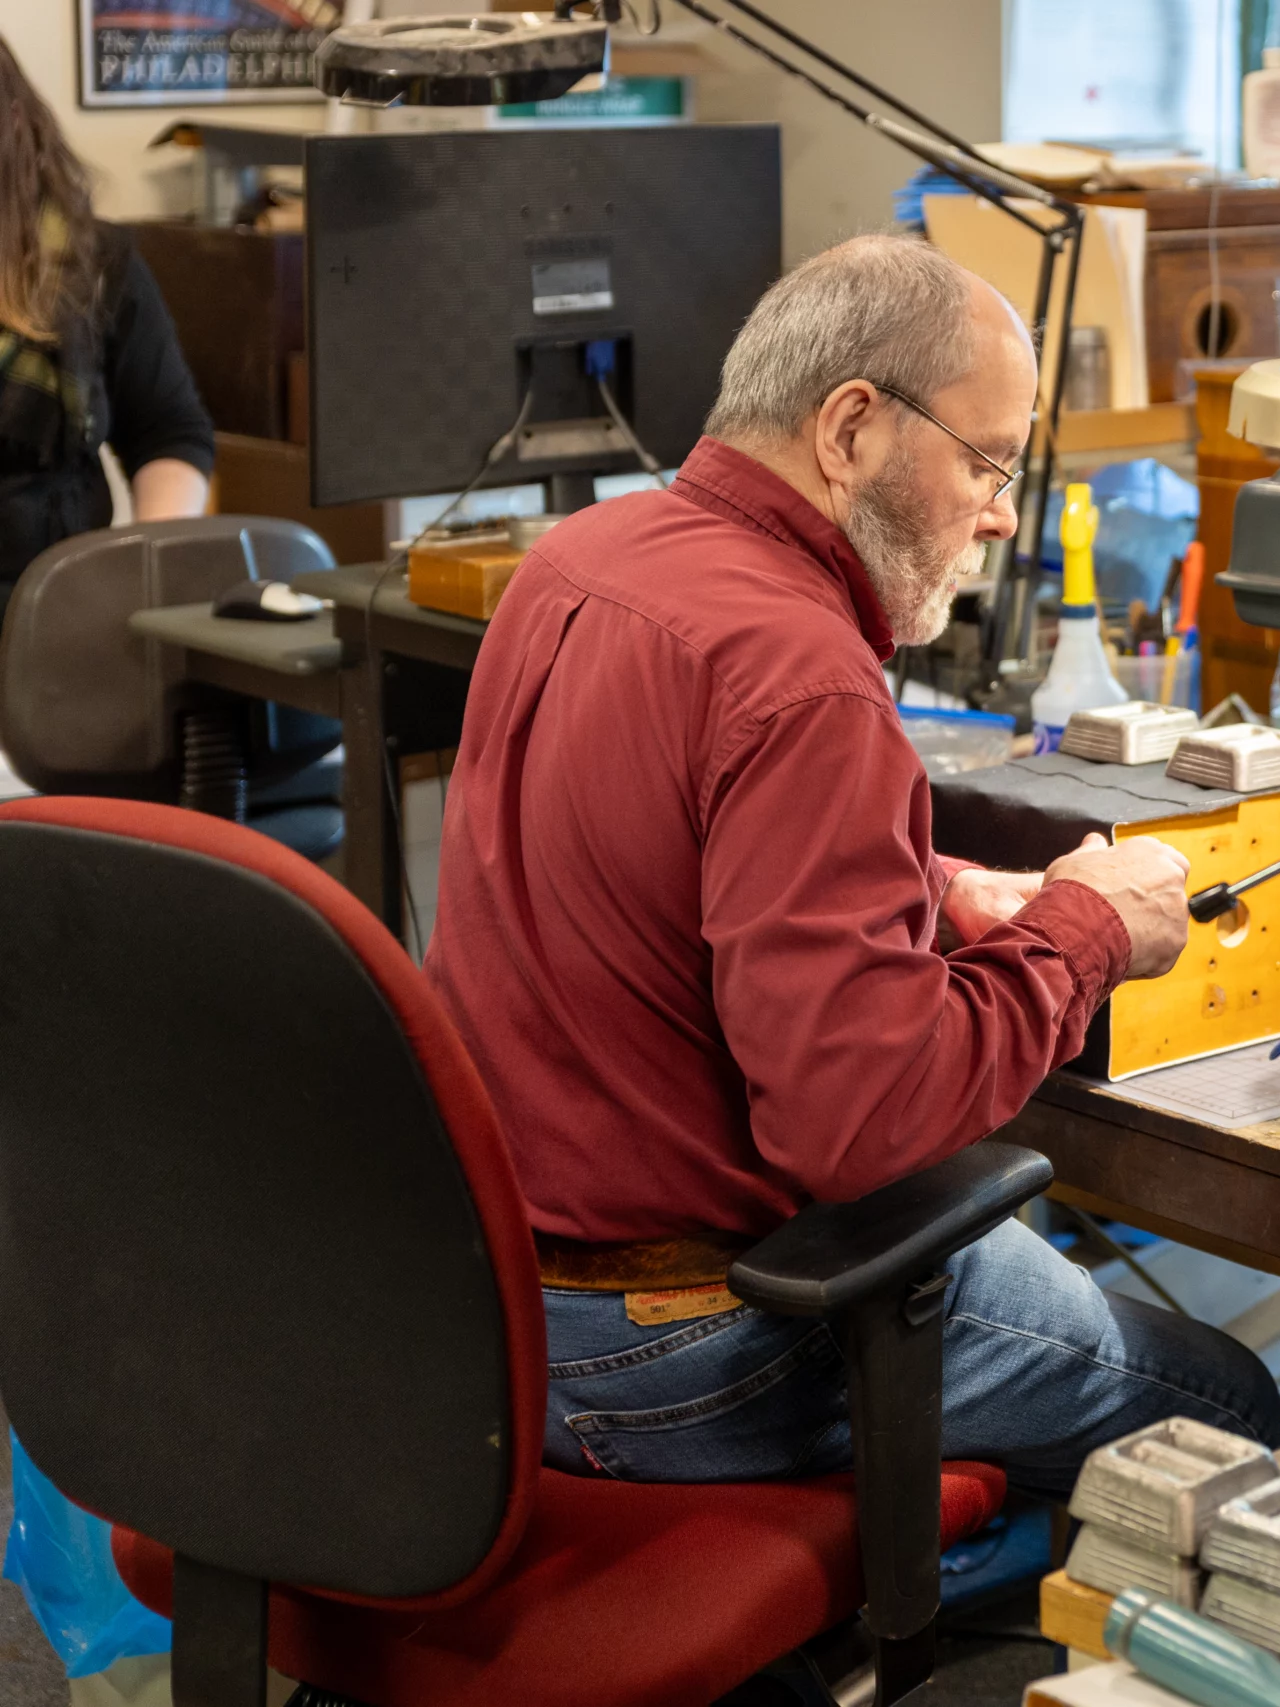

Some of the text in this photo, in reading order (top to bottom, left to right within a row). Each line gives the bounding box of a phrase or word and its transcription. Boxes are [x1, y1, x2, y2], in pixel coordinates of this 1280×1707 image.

[99, 28, 135, 53] The
[141, 29, 228, 53] American
[230, 28, 283, 52] Guild
